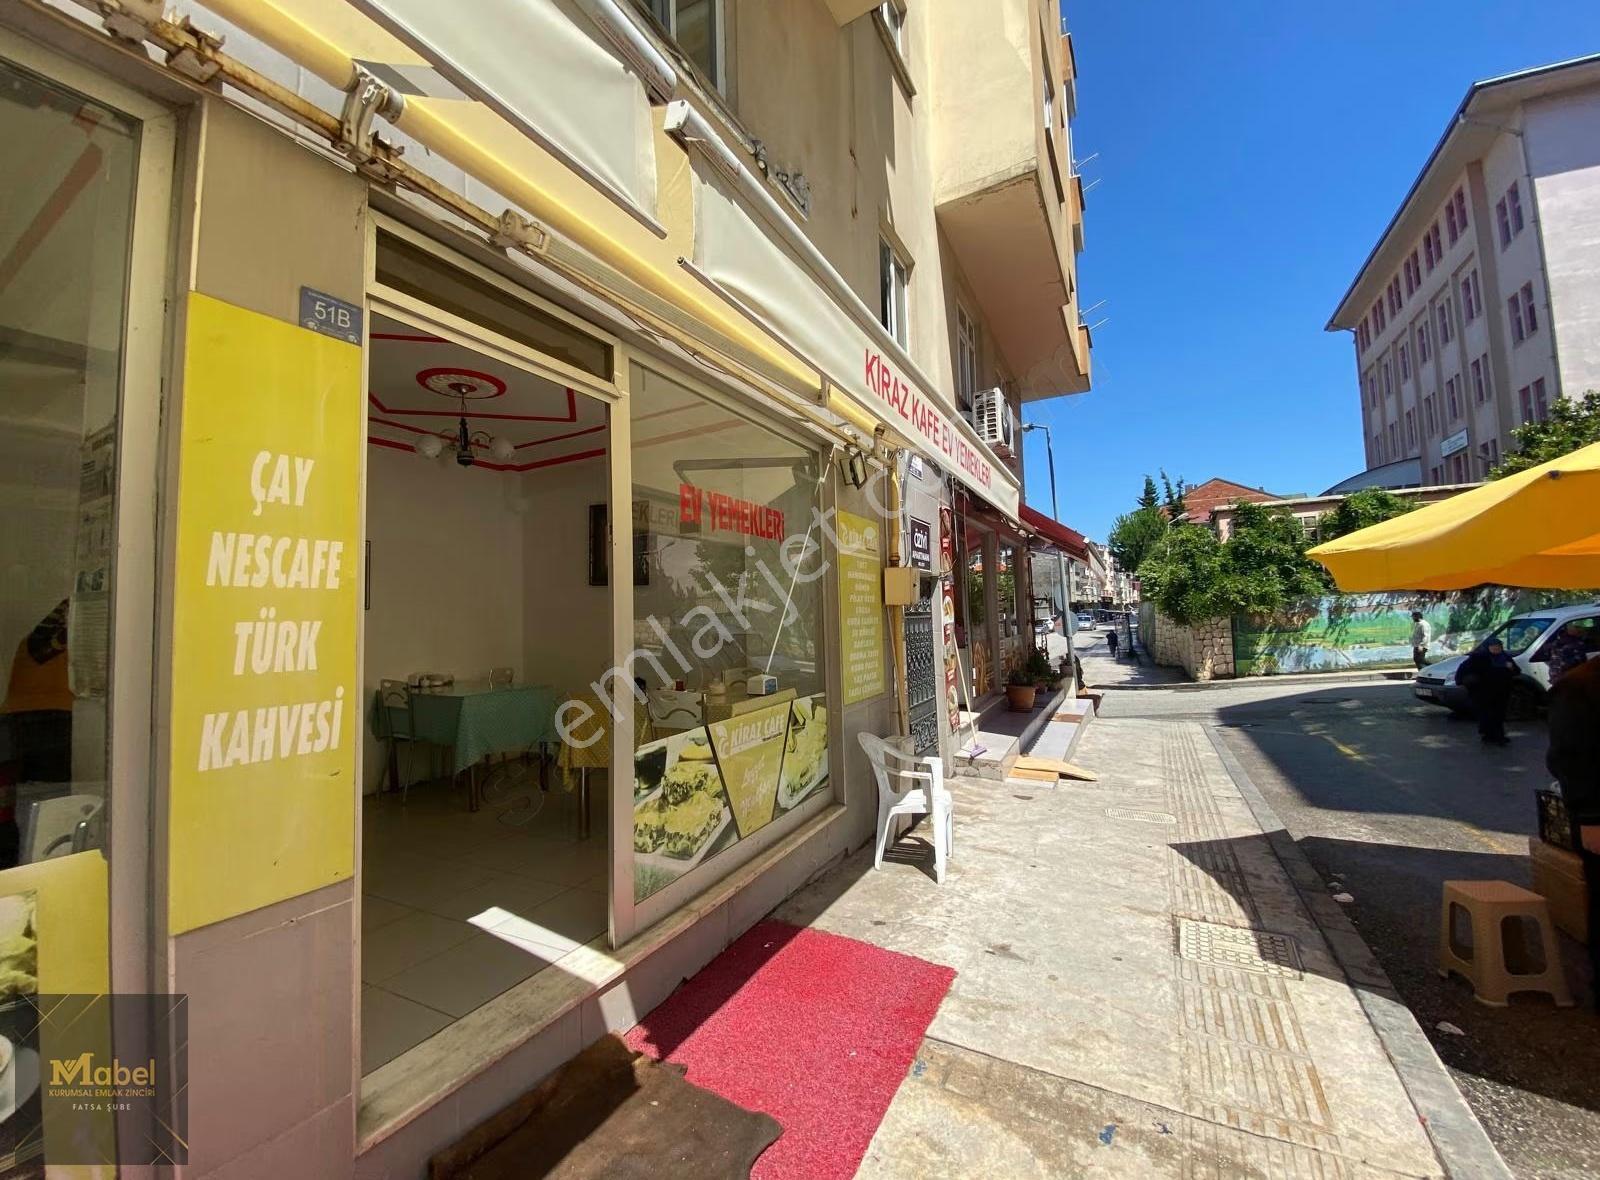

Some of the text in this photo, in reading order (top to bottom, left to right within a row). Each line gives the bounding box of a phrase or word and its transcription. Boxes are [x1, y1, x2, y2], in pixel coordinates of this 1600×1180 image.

[314, 301, 351, 328] 51B
[864, 348, 909, 421] KİRAZ
[911, 393, 940, 446] KAFE
[942, 423, 954, 457] EV
[955, 436, 992, 490] YEMEKLERİ
[249, 450, 315, 515] ÇAY
[680, 483, 785, 544] EV YEMEKLERİ
[206, 531, 344, 589] NESCAFE
[233, 605, 320, 676] TÜRK
[197, 686, 345, 772] KAHVESİ
[763, 714, 785, 736] CAFE
